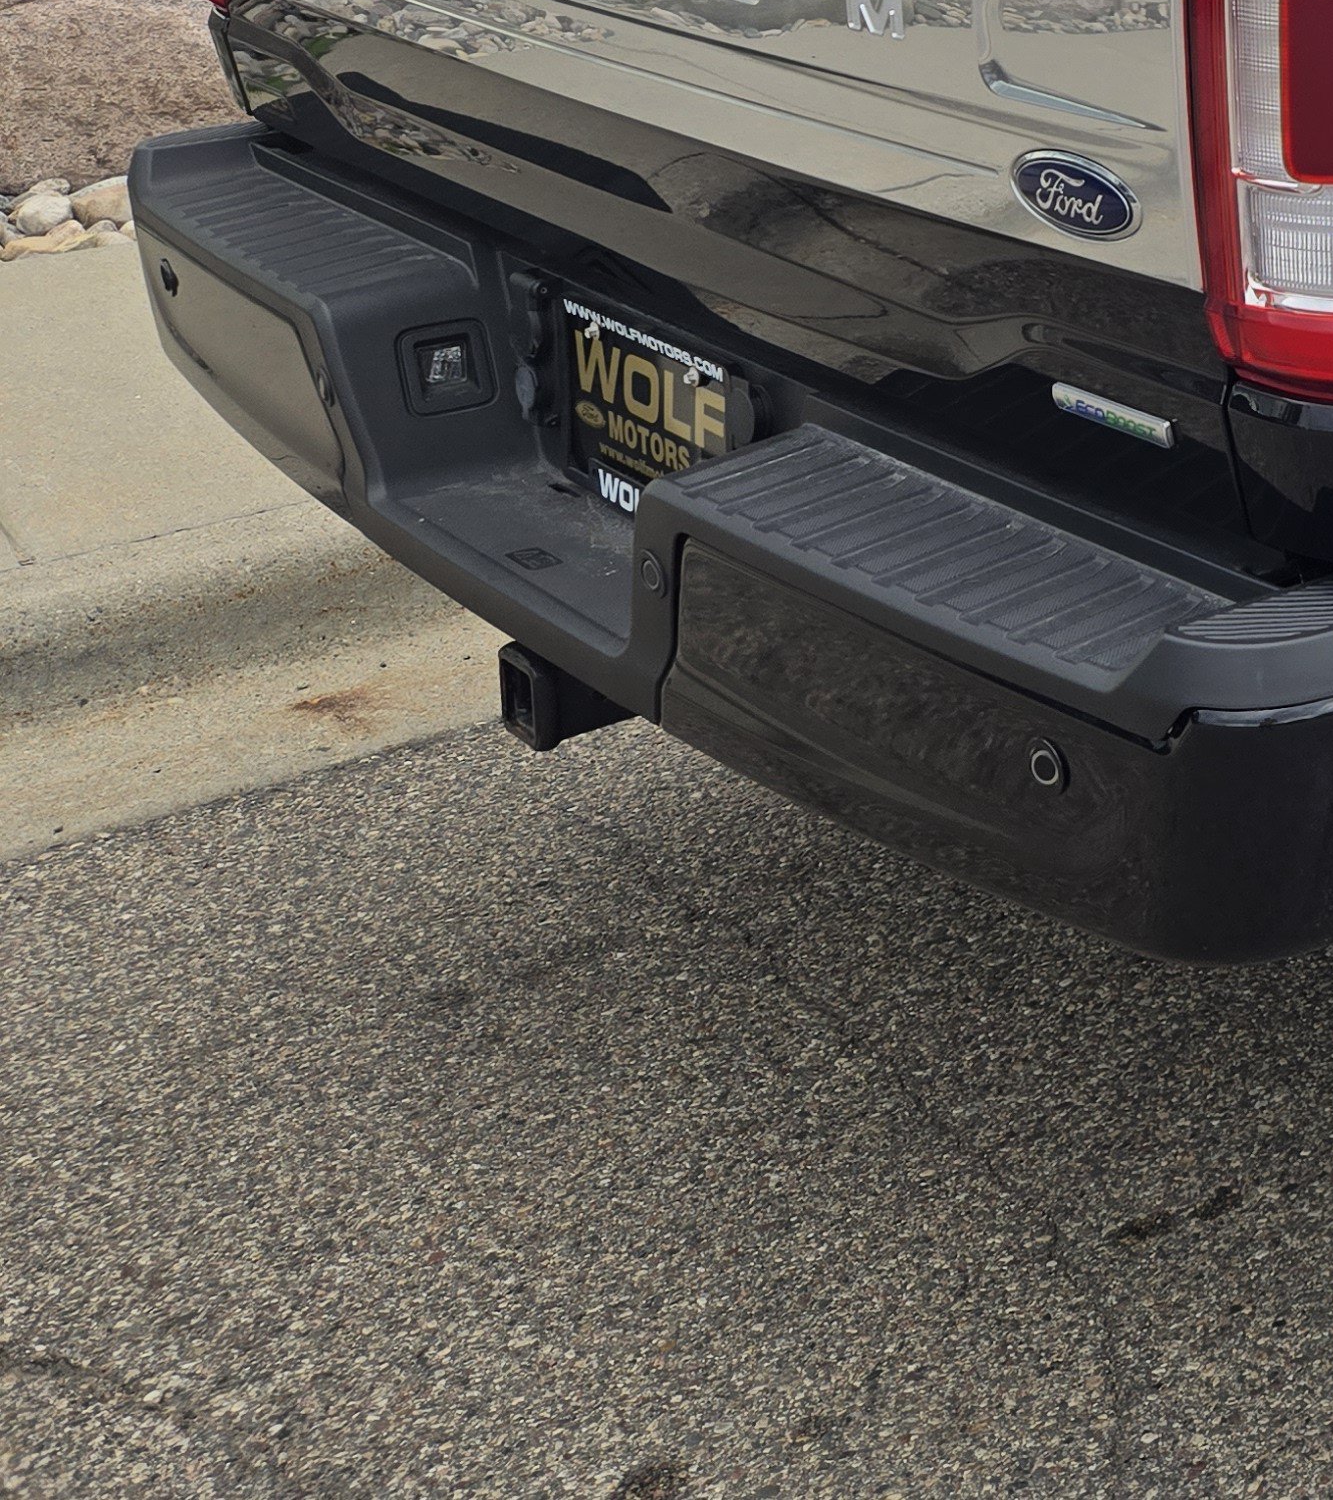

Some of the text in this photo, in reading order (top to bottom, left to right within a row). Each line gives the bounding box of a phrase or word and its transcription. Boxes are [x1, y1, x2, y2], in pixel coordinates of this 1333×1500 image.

[1035, 168, 1104, 226] Ford
[563, 298, 724, 383] WWW.WOLFMOTORS.COM
[574, 329, 726, 449] WOLF
[608, 411, 690, 471] MOTORS
